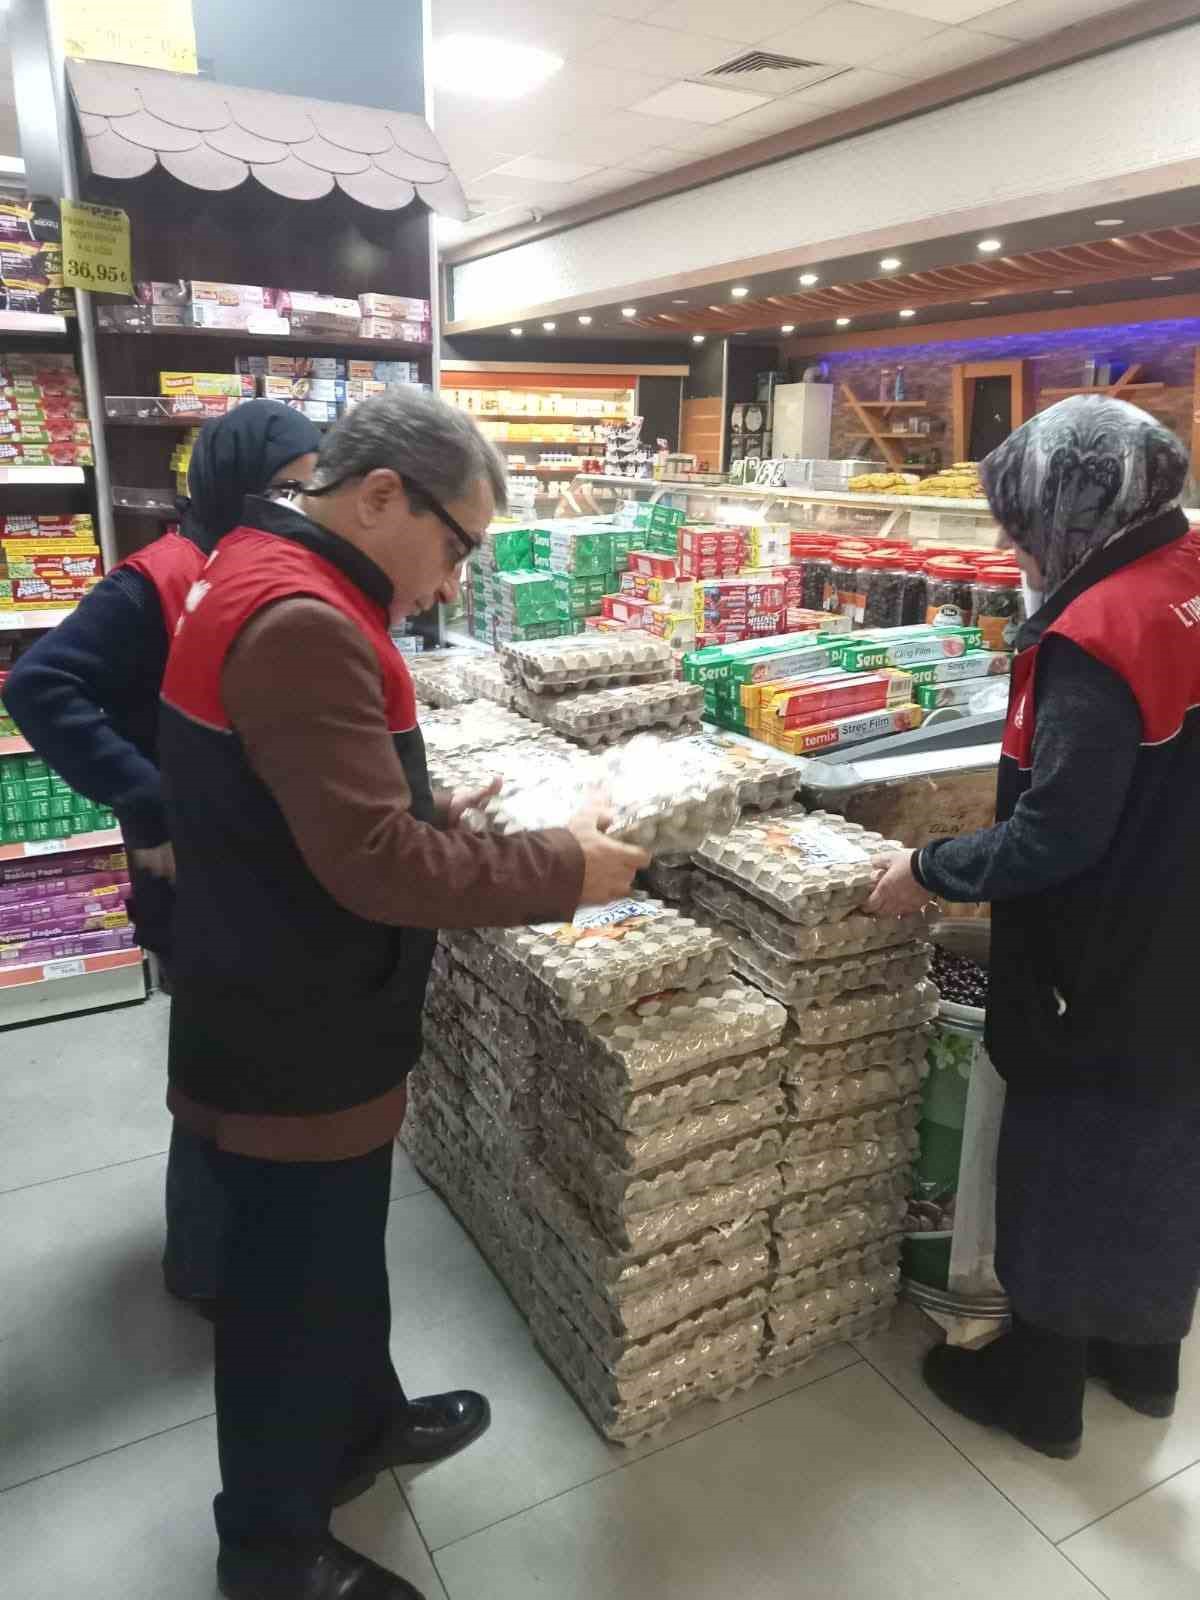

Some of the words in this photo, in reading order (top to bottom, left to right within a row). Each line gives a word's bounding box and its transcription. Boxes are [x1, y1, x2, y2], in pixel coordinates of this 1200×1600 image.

[856, 652, 883, 668] Sera
[698, 665, 728, 681] Sera
[912, 670, 932, 684] era
[868, 716, 889, 730] Film
[804, 729, 838, 747] temix
